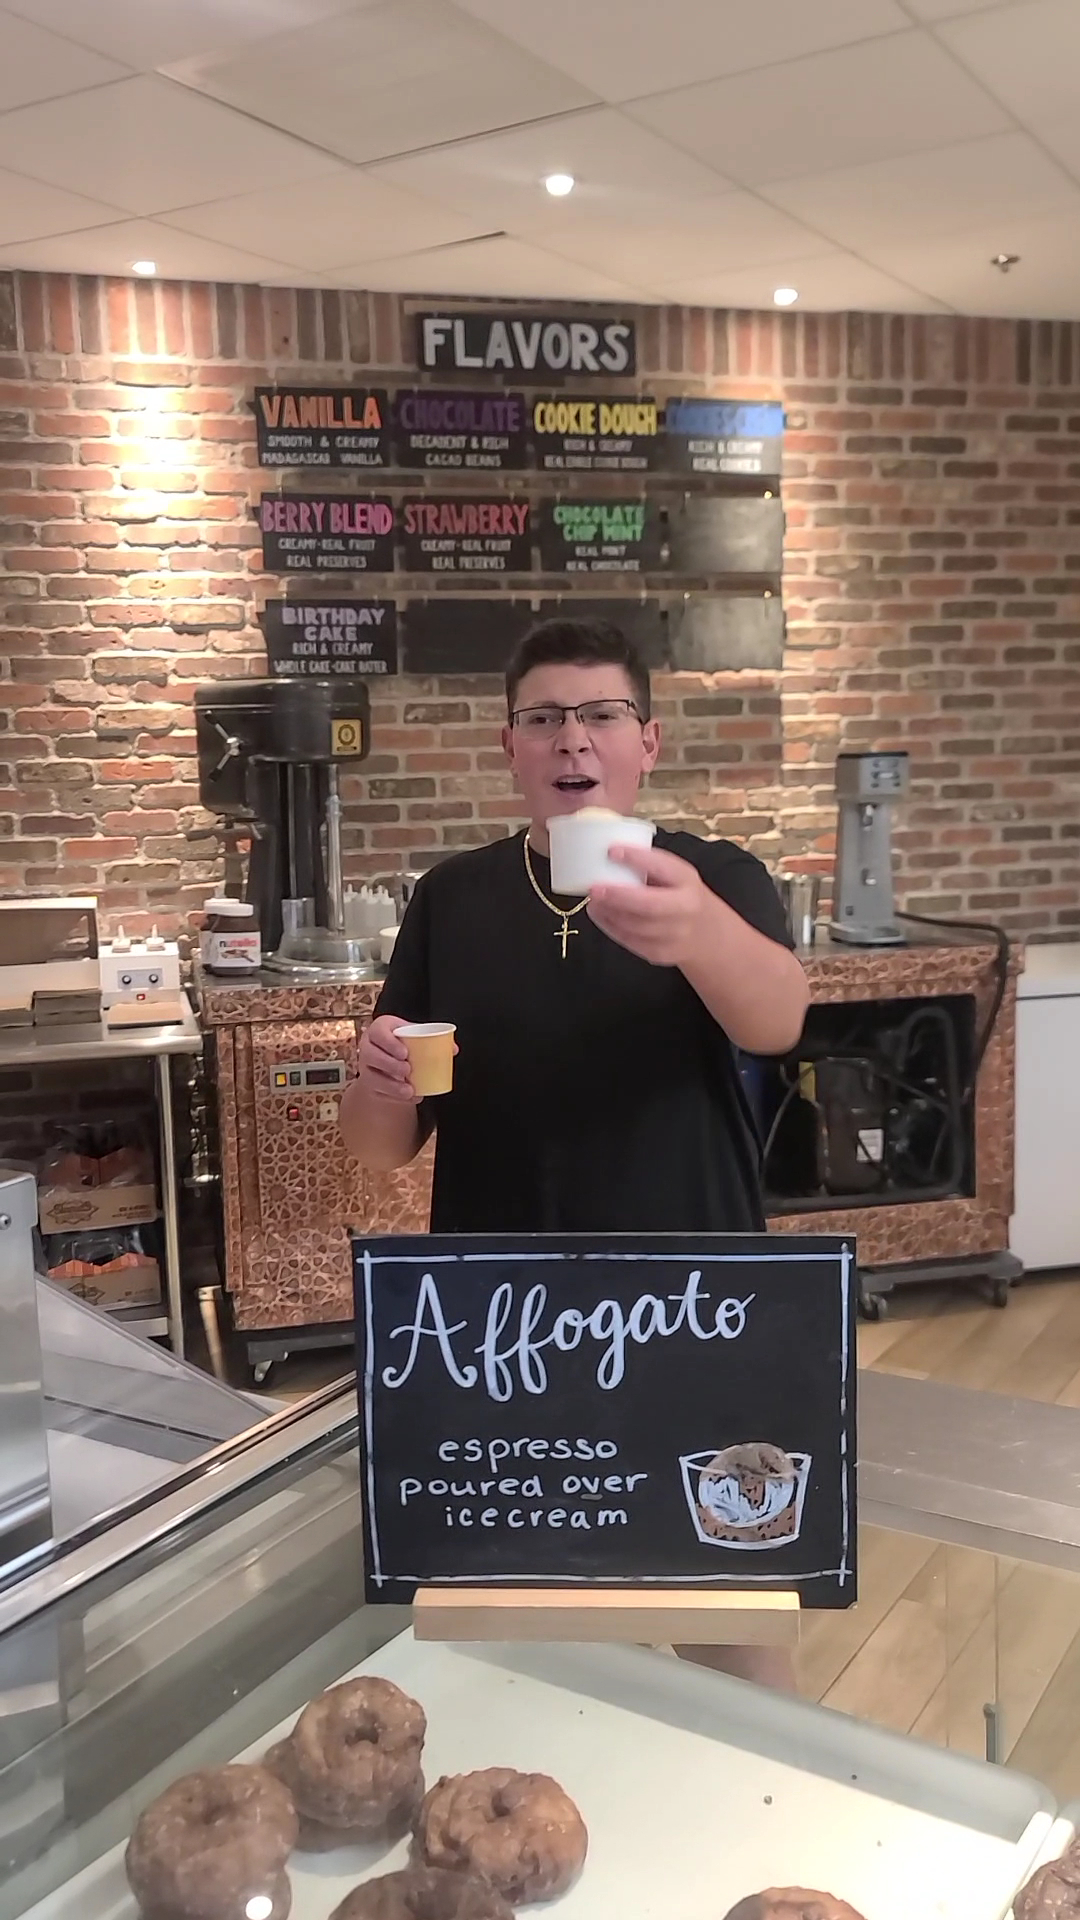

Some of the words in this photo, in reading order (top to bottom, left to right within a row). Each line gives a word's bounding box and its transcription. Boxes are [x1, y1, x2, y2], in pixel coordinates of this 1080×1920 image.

[423, 319, 630, 371] FLAVORS
[260, 395, 382, 429] VANILLA
[400, 398, 520, 432] CHOCOLATE
[534, 402, 596, 434] COOKIE
[599, 403, 657, 435] DOUGH
[267, 436, 312, 447] SMOOTH
[320, 437, 329, 447] &
[335, 437, 379, 448] CREAMY
[470, 437, 479, 449] &
[262, 452, 330, 464] MADAGASCAR
[340, 453, 383, 464] VANILLA
[425, 453, 462, 465] CACAO
[261, 501, 325, 533] BERRY
[330, 502, 393, 534] BLEND
[404, 504, 528, 535] STRAWBERRY
[553, 506, 644, 524] CHOCOLATE
[563, 525, 597, 541] CHIP
[602, 525, 642, 541] MINT
[287, 555, 312, 567] REAL
[316, 555, 367, 568] PRESERVES
[432, 556, 456, 569] REAL
[282, 607, 385, 625] BIRTHDAY
[304, 626, 357, 641] CAKE
[292, 643, 317, 655] RICH
[320, 643, 328, 655] &
[332, 643, 373, 655] CREAMY
[273, 660, 306, 673] WHOLE
[381, 1269, 757, 1403] Affogato
[438, 1437, 618, 1474] espresso
[398, 1474, 543, 1507] poured
[562, 1471, 648, 1494] over
